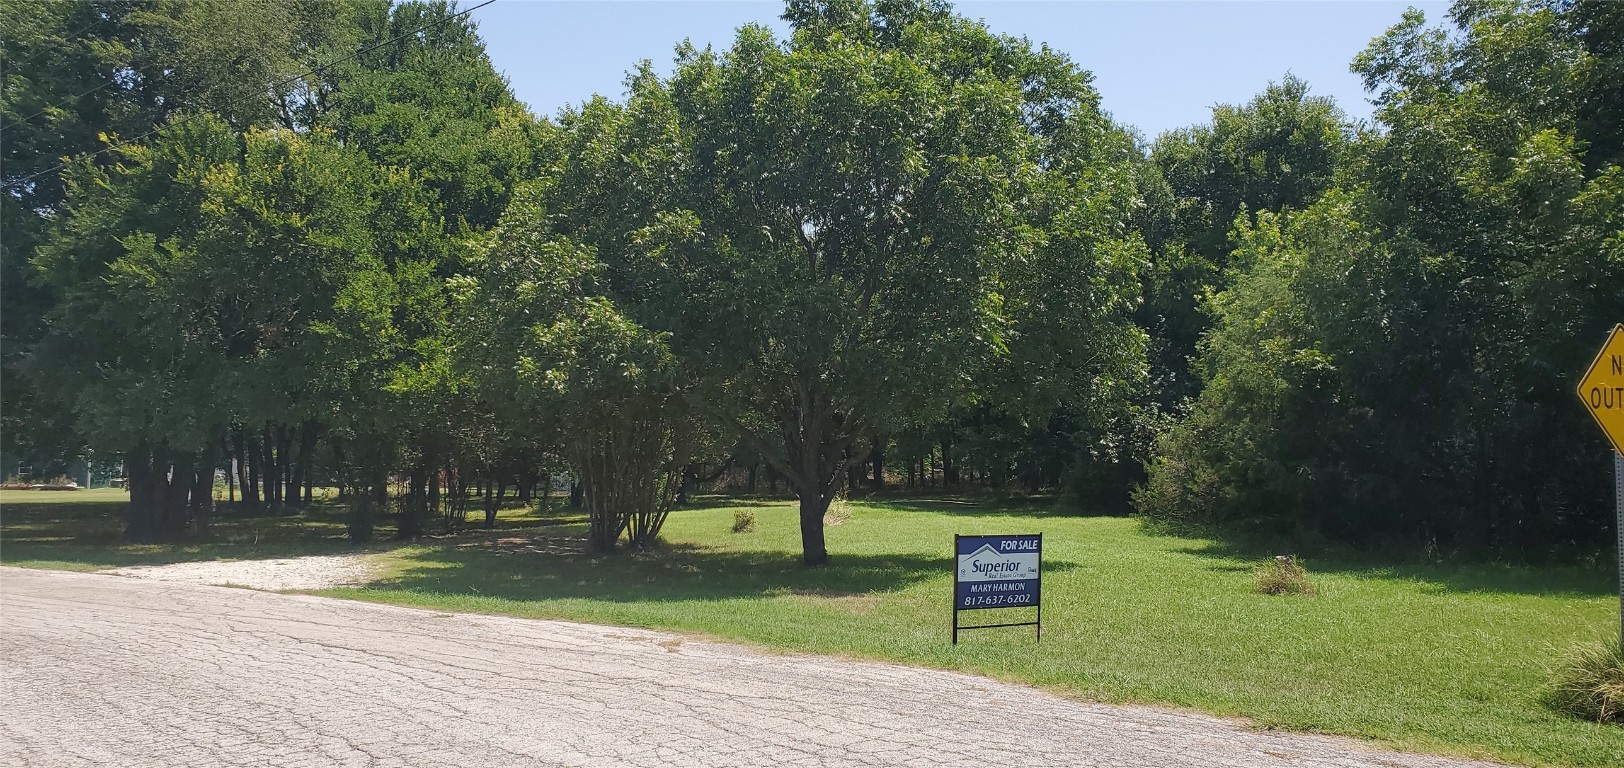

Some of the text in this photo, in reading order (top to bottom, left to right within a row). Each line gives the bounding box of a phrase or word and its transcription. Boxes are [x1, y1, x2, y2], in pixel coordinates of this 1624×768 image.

[1000, 540, 1038, 551] FOR SALE
[971, 559, 1021, 576] Superior
[970, 582, 1026, 593] MARY HARMON
[964, 593, 1031, 606] 817-637-6202
